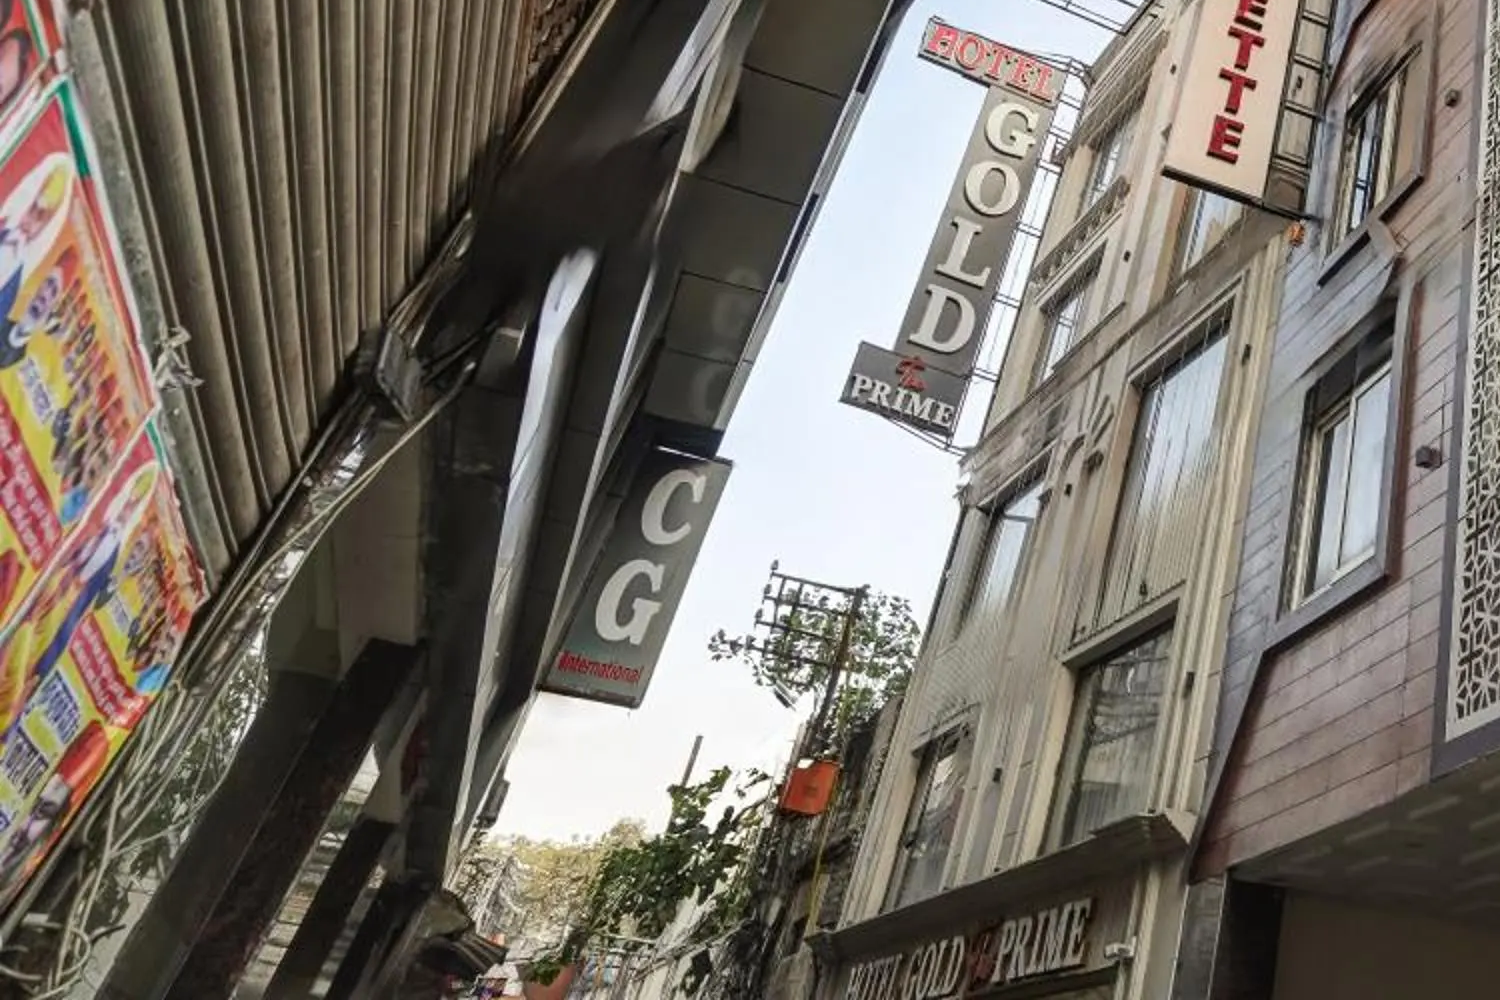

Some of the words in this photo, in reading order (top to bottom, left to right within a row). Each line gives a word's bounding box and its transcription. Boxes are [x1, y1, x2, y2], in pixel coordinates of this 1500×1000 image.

[923, 21, 1056, 102] HOTEL
[910, 101, 1036, 354] GOLD
[851, 373, 955, 428] PRIME
[990, 900, 1092, 984] PRIME
